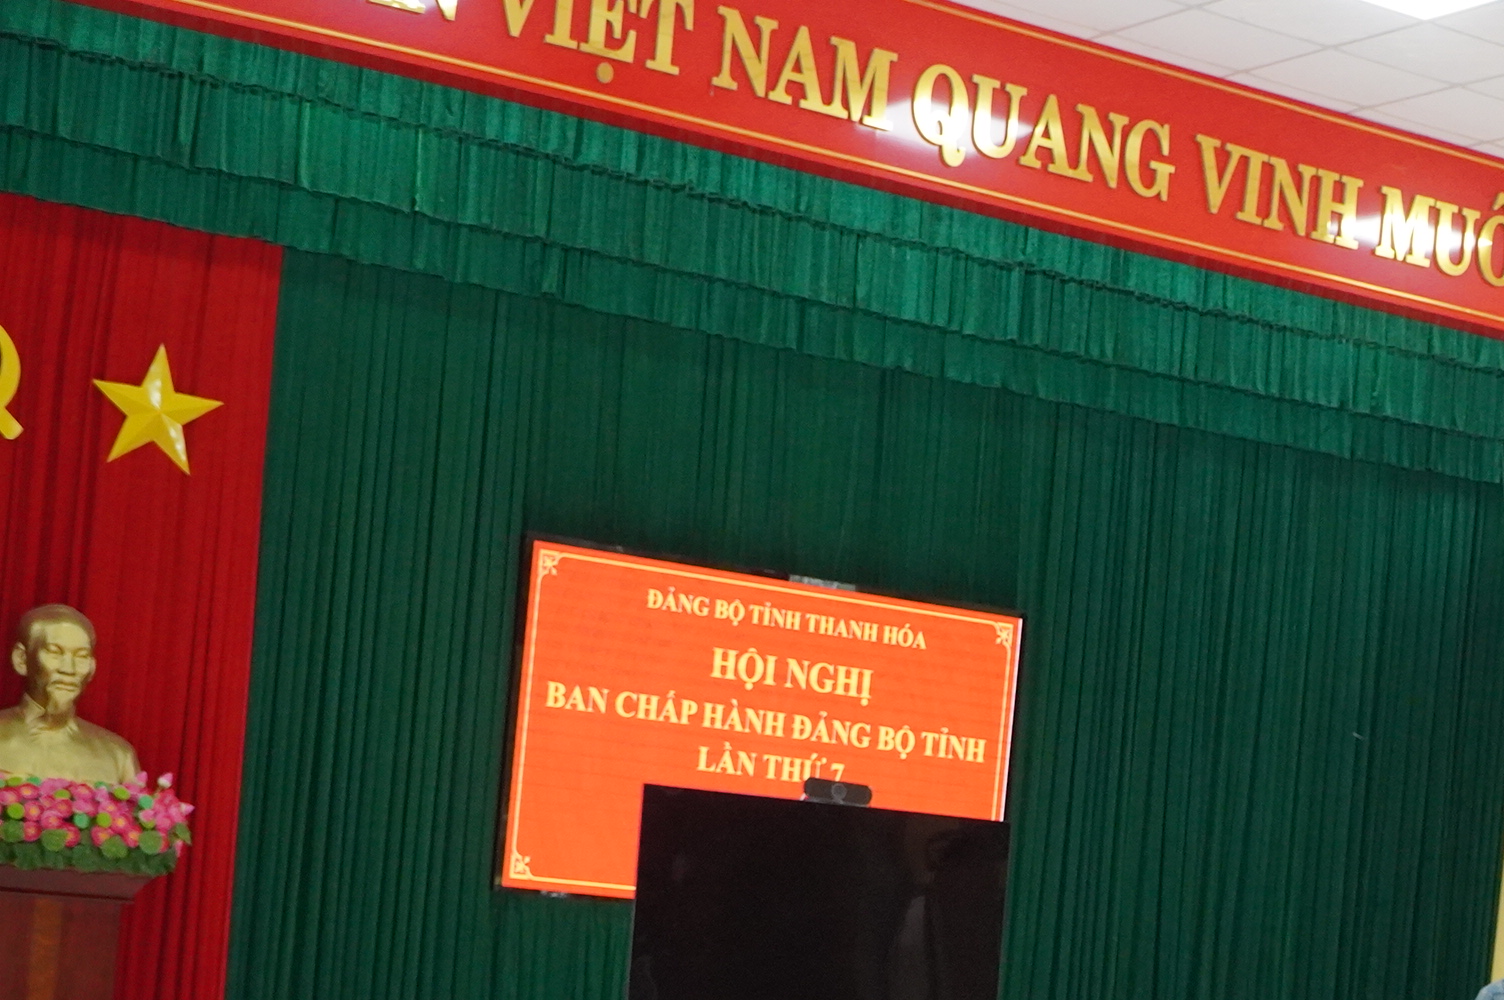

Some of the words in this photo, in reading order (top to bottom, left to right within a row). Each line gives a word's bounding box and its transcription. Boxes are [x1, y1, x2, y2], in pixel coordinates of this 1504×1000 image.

[712, 6, 899, 131] NAM
[912, 64, 1177, 201] QUANG
[1194, 133, 1365, 251] VINH
[647, 588, 710, 618] ĐẢNG
[714, 602, 745, 625] BỘ
[749, 602, 802, 631] TỈNH
[806, 612, 879, 644] THANH
[883, 620, 927, 650] HÓA
[710, 647, 777, 690] HỘI
[785, 657, 874, 706] NGHỊ
[546, 681, 607, 714] BAN
[615, 689, 698, 724] CHẤP
[704, 699, 785, 738] HÀNH
[793, 714, 872, 748] ĐẢNG
[877, 728, 915, 760] BỘ
[922, 727, 986, 764] TỈNH
[697, 741, 758, 777] LẦN
[763, 753, 827, 782] THỨ
[830, 763, 846, 782] 7
